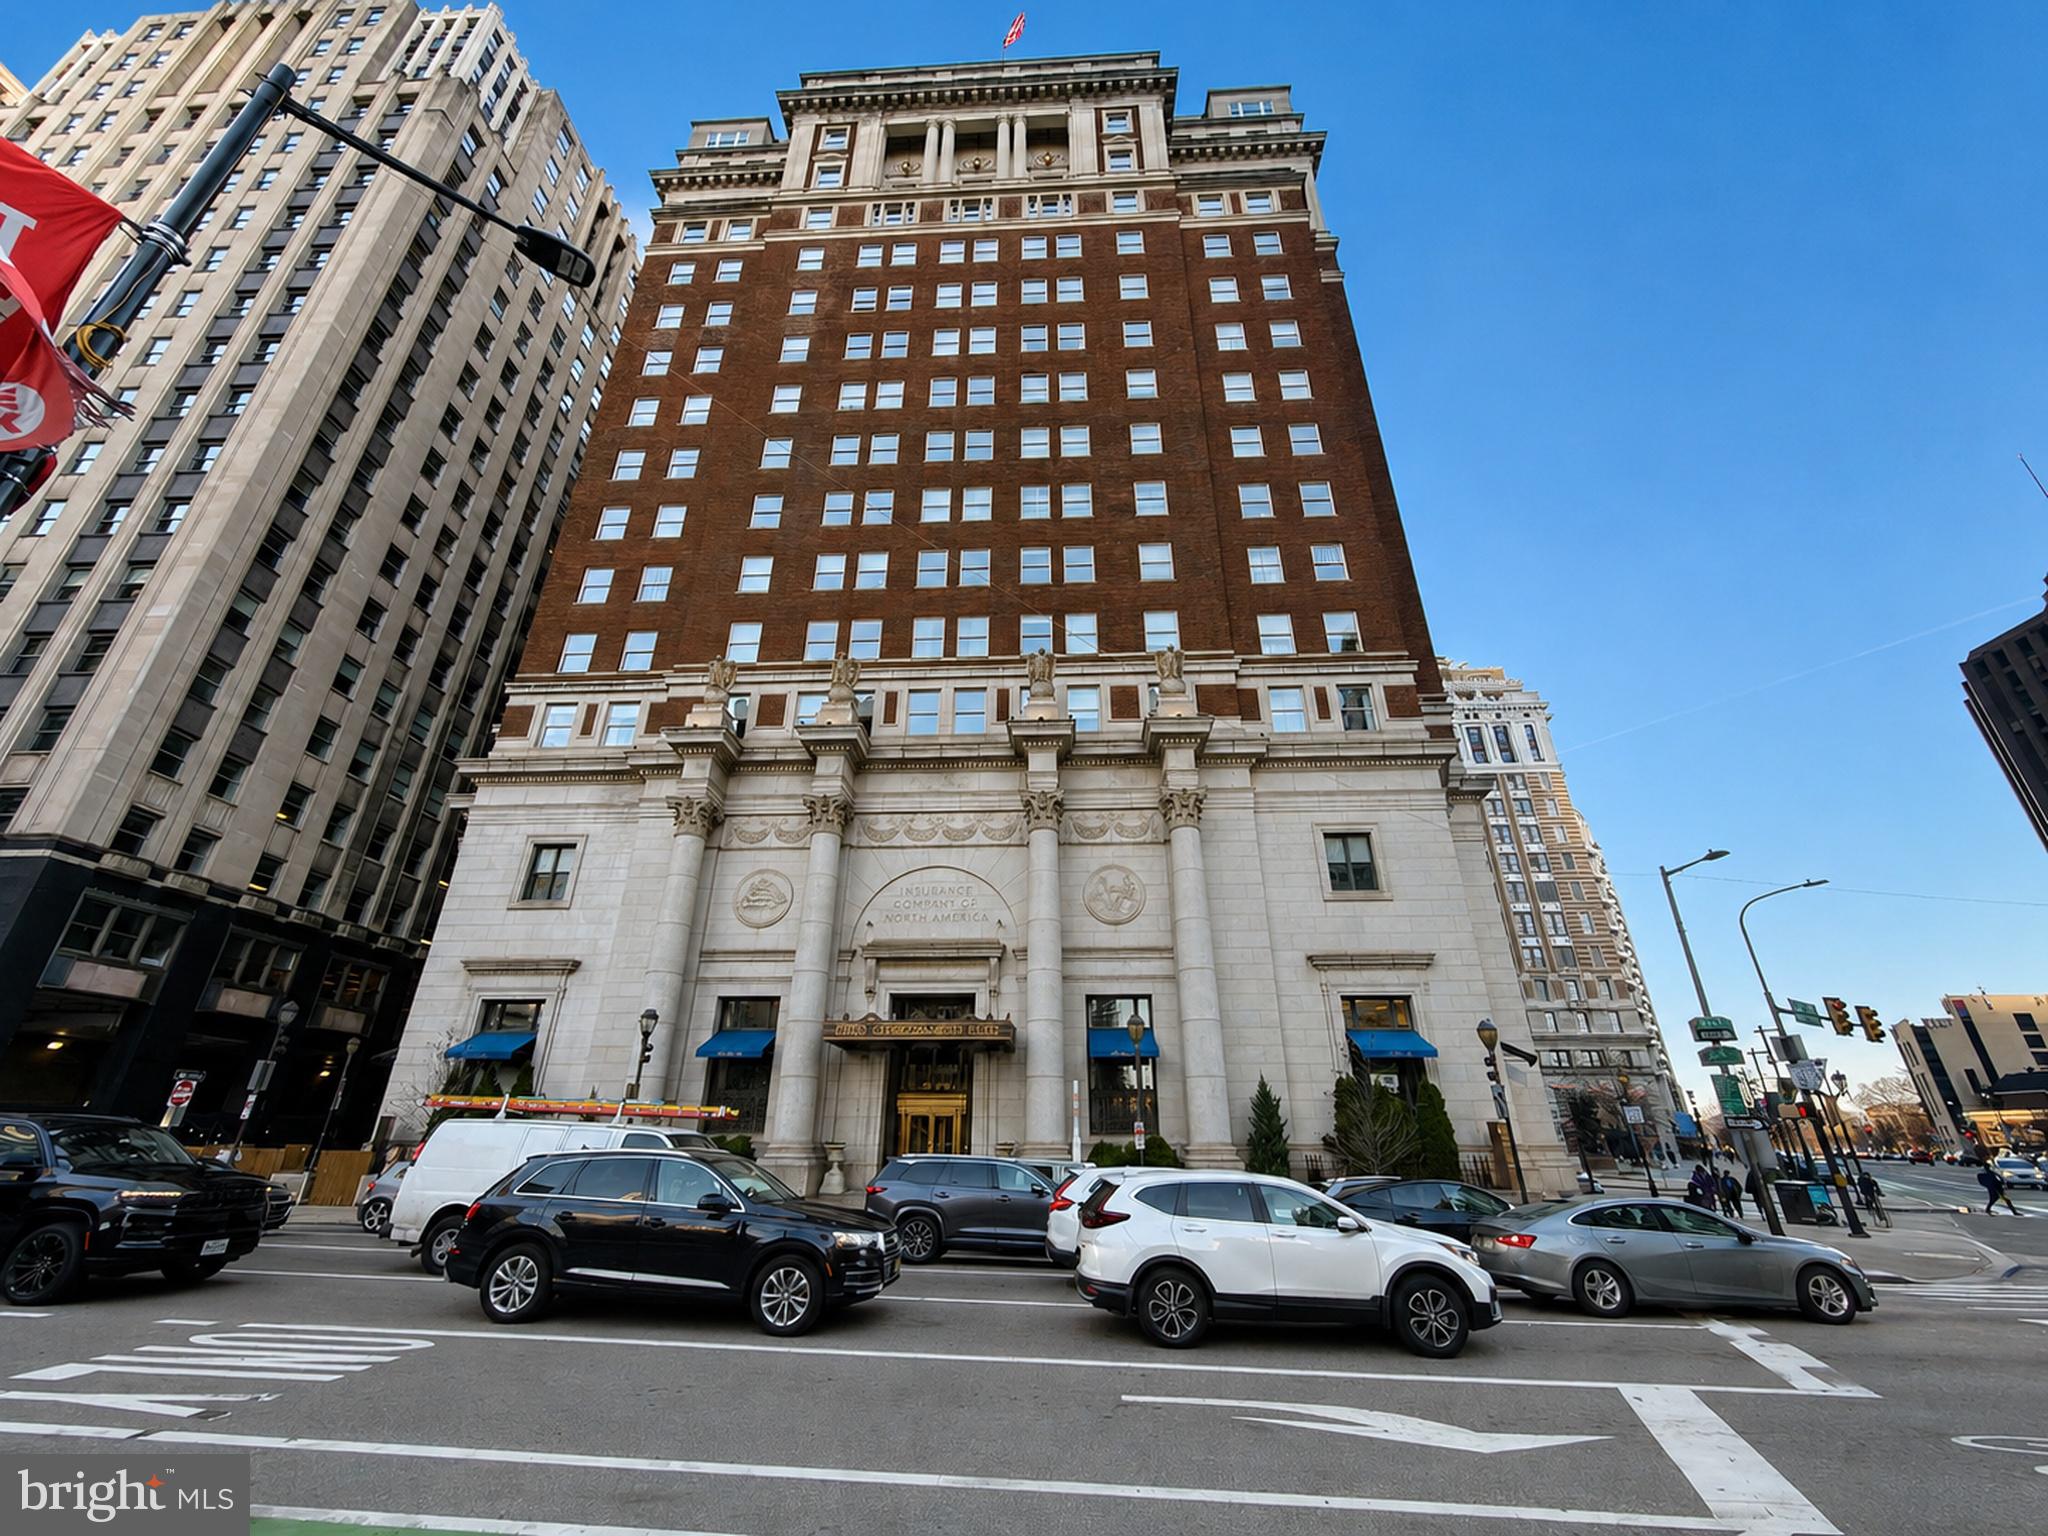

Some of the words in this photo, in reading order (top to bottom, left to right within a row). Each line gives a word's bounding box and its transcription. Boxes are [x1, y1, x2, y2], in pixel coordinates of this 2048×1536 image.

[900, 886, 973, 897] INSURANCE
[893, 899, 956, 910] COMPANY
[960, 898, 977, 909] OF
[883, 913, 928, 924] NORTH
[931, 912, 990, 923] AMERICA
